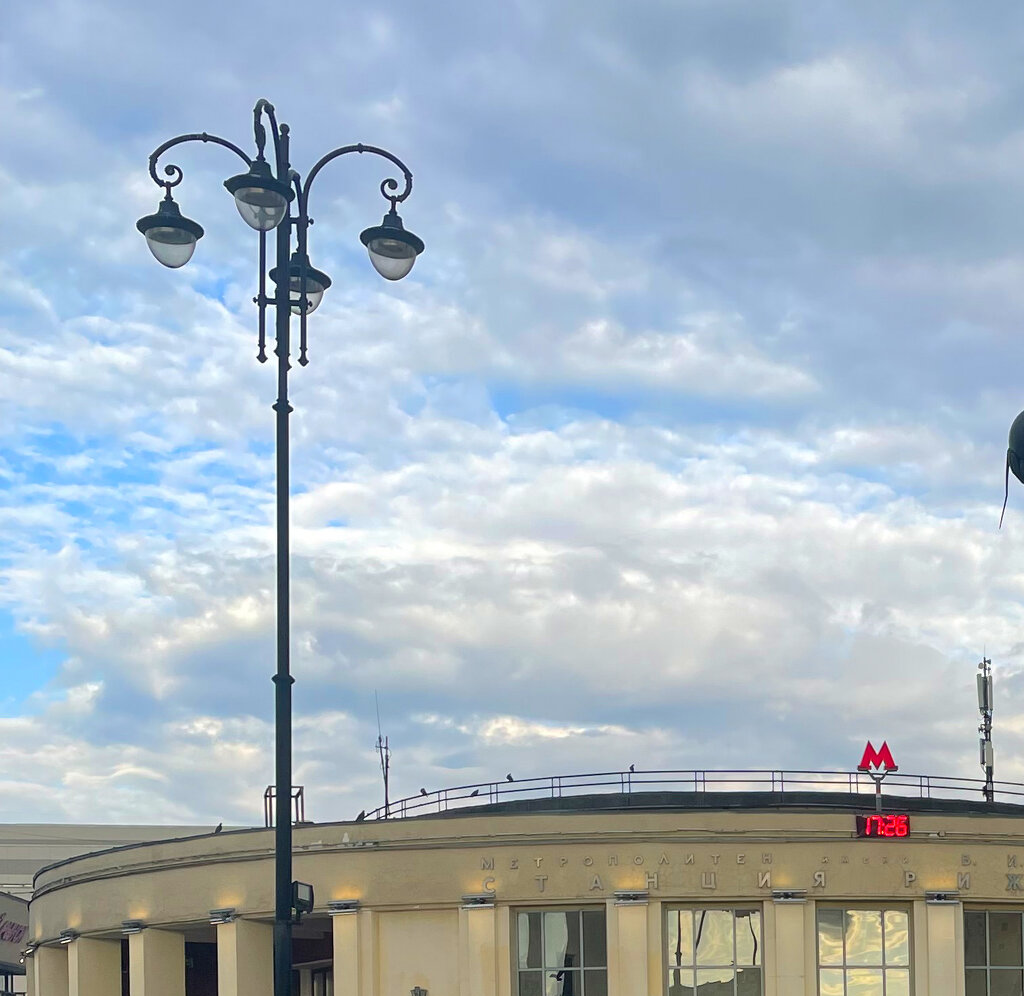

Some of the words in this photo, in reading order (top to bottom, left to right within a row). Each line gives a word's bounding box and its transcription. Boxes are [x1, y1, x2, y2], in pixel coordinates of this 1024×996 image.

[858, 740, 898, 771] М
[865, 815, 908, 837] 17:26
[481, 853, 772, 871] МЕТРОПОЛИТЕН
[1007, 854, 1024, 868] И.
[481, 871, 826, 893] СТАНЦИЯ
